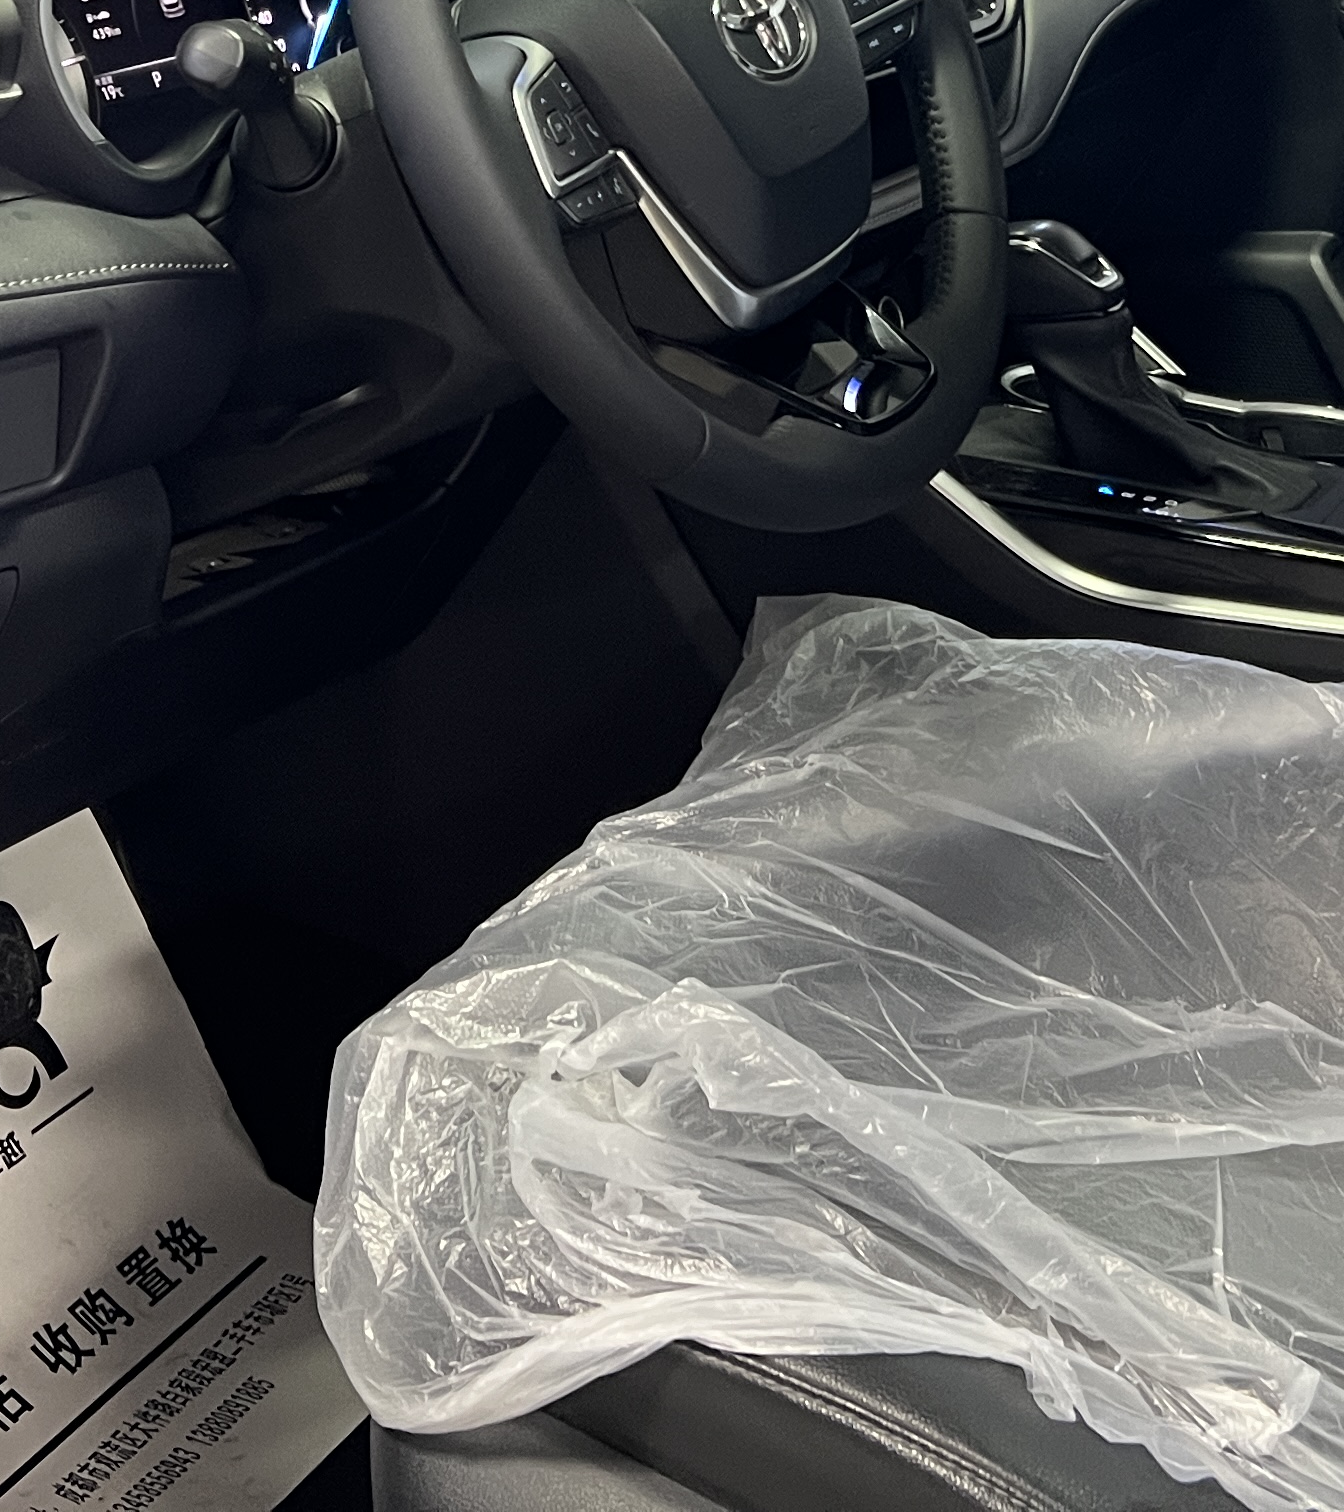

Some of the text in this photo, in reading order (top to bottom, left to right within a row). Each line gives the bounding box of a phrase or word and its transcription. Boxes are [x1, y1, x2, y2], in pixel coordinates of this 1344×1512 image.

[150, 71, 162, 89] P
[30, 1287, 135, 1375] 收购
[115, 1216, 219, 1308] 置换
